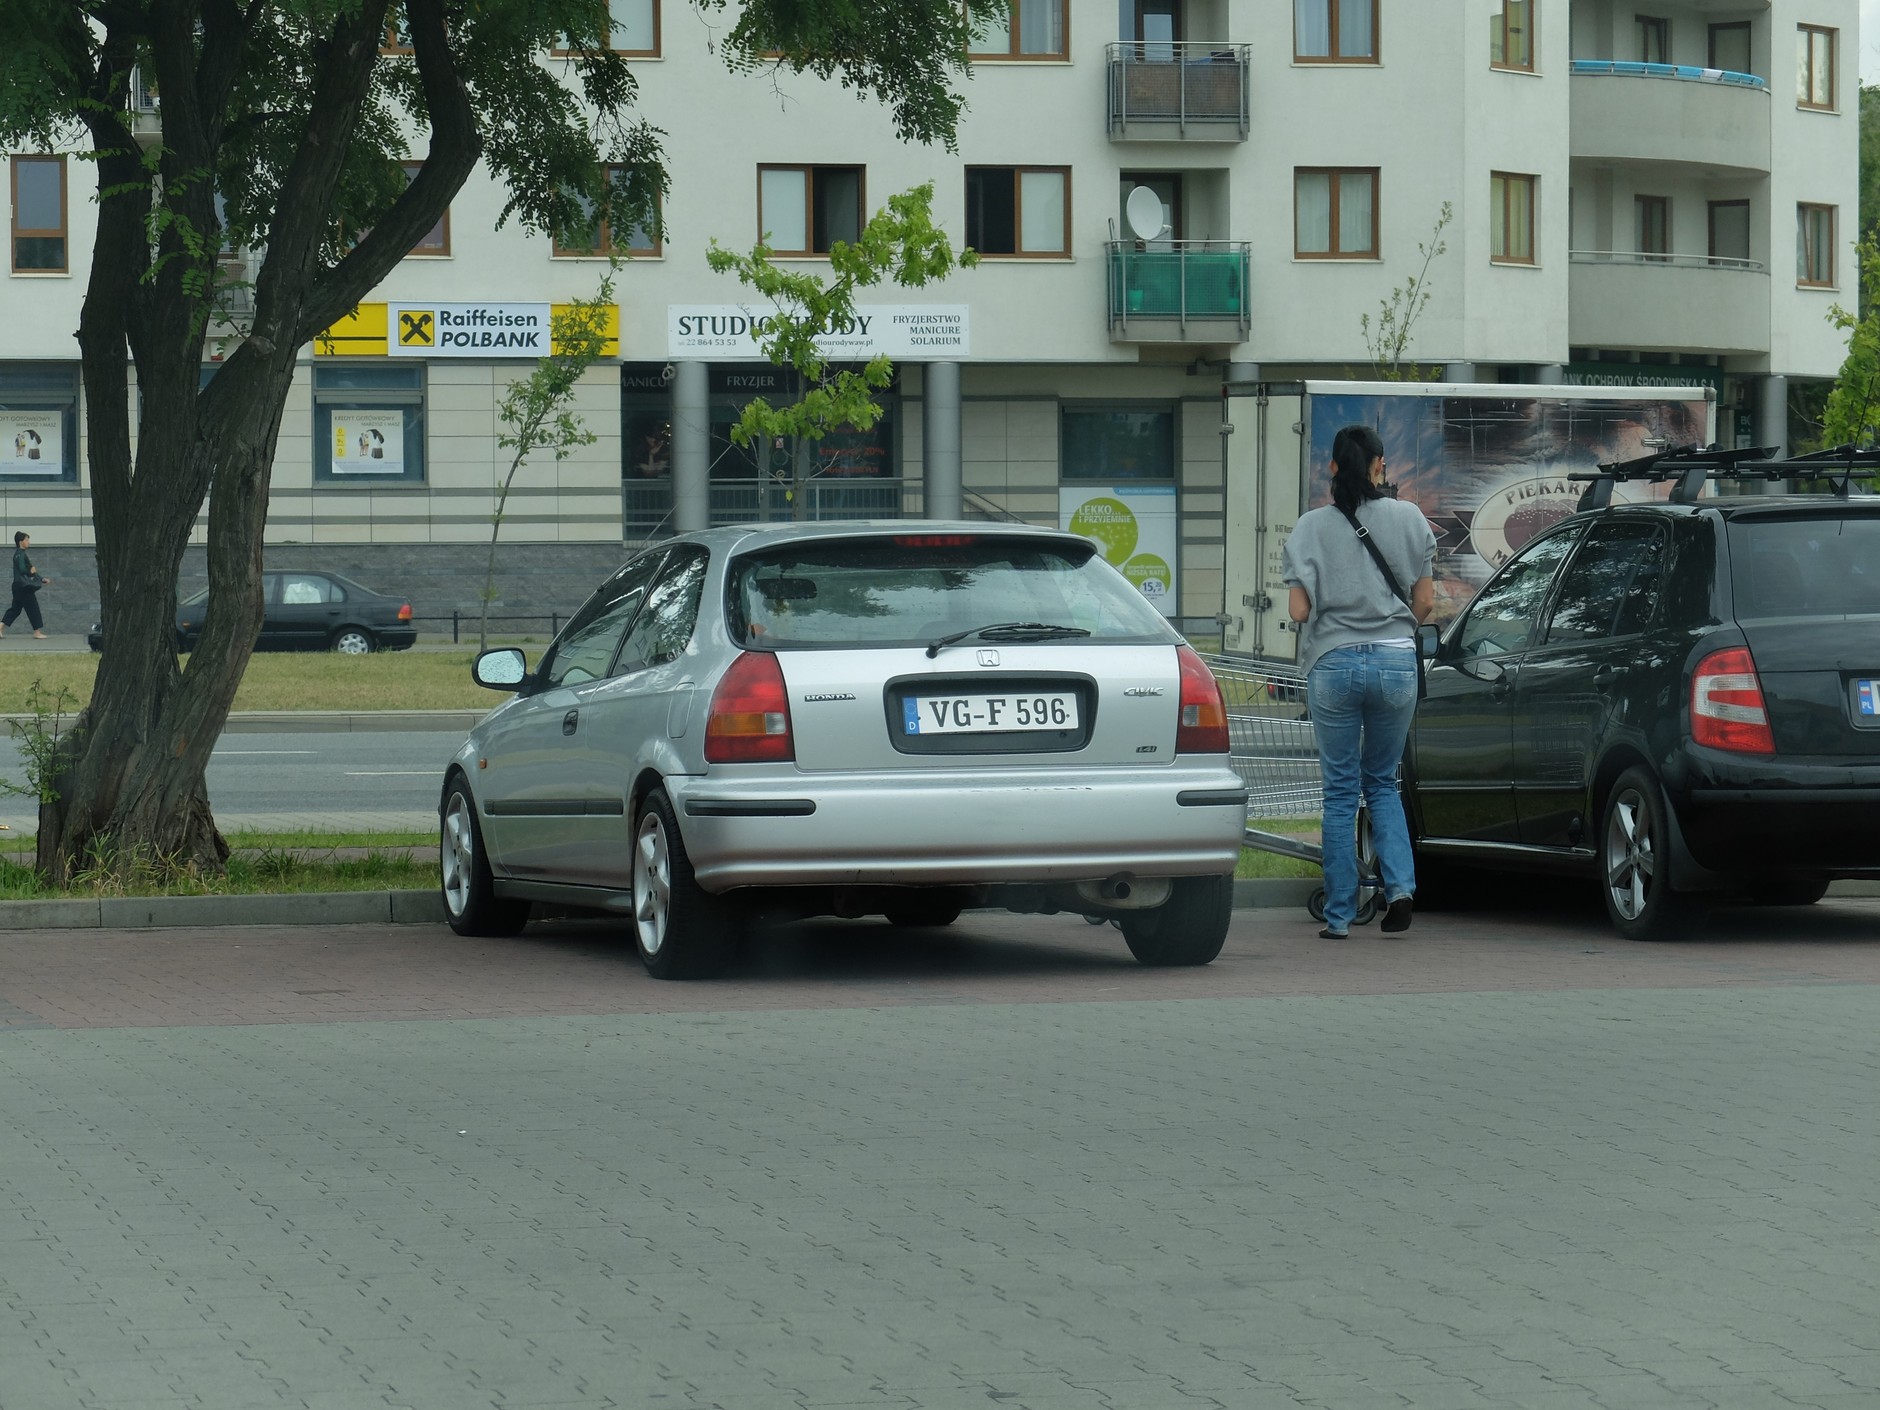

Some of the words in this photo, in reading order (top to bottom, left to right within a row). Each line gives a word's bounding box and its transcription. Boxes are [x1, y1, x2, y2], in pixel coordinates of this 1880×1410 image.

[440, 309, 538, 326] Raiffeisen
[893, 315, 961, 324] FRYZJERSTWO
[909, 326, 961, 334] MANICURE
[440, 332, 540, 347] POLBANK
[910, 337, 961, 345] SOLARIUM
[727, 375, 775, 388] FRYZJER
[1586, 374, 1633, 386] OCHRONY
[1084, 515, 1132, 523] PRZYJEMNIE
[804, 692, 856, 702] HONDA
[1123, 687, 1164, 697] CIVIC
[1862, 701, 1872, 709] PL
[929, 699, 1006, 728] VG-F
[1016, 698, 1066, 726] 596
[909, 721, 916, 731] D
